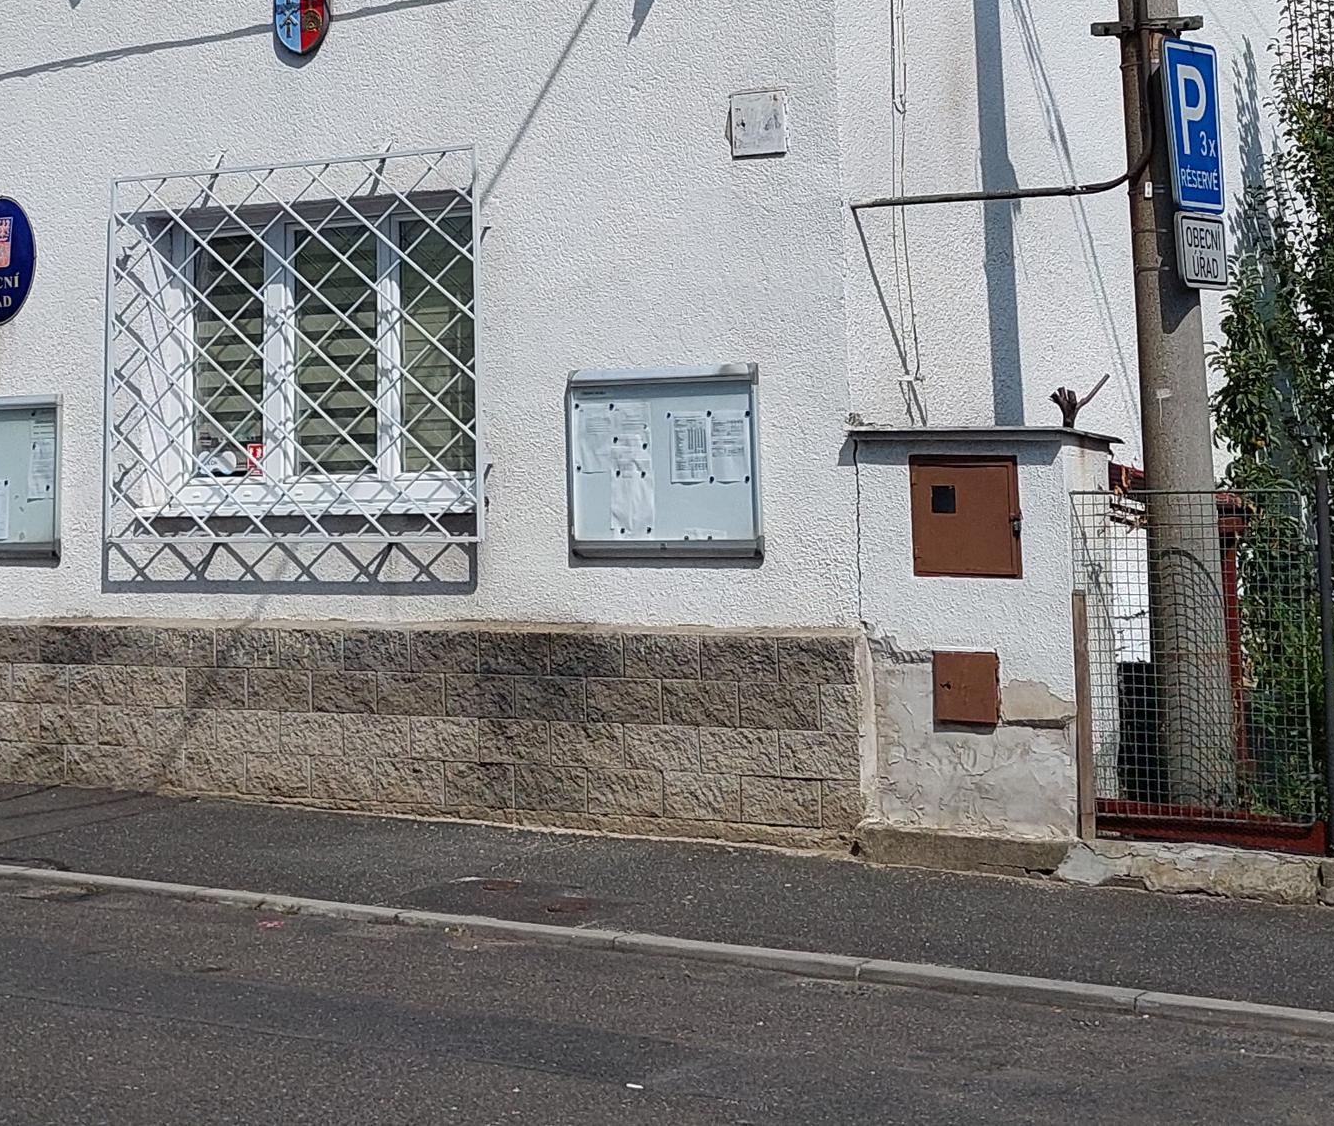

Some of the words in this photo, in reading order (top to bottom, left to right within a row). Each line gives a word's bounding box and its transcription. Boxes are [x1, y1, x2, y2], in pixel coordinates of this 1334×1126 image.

[1176, 64, 1206, 155] P
[1181, 165, 1219, 191] RÉSERVÉ
[1186, 226, 1221, 251] OBECNÍ
[1192, 250, 1219, 279] ÚŘAD
